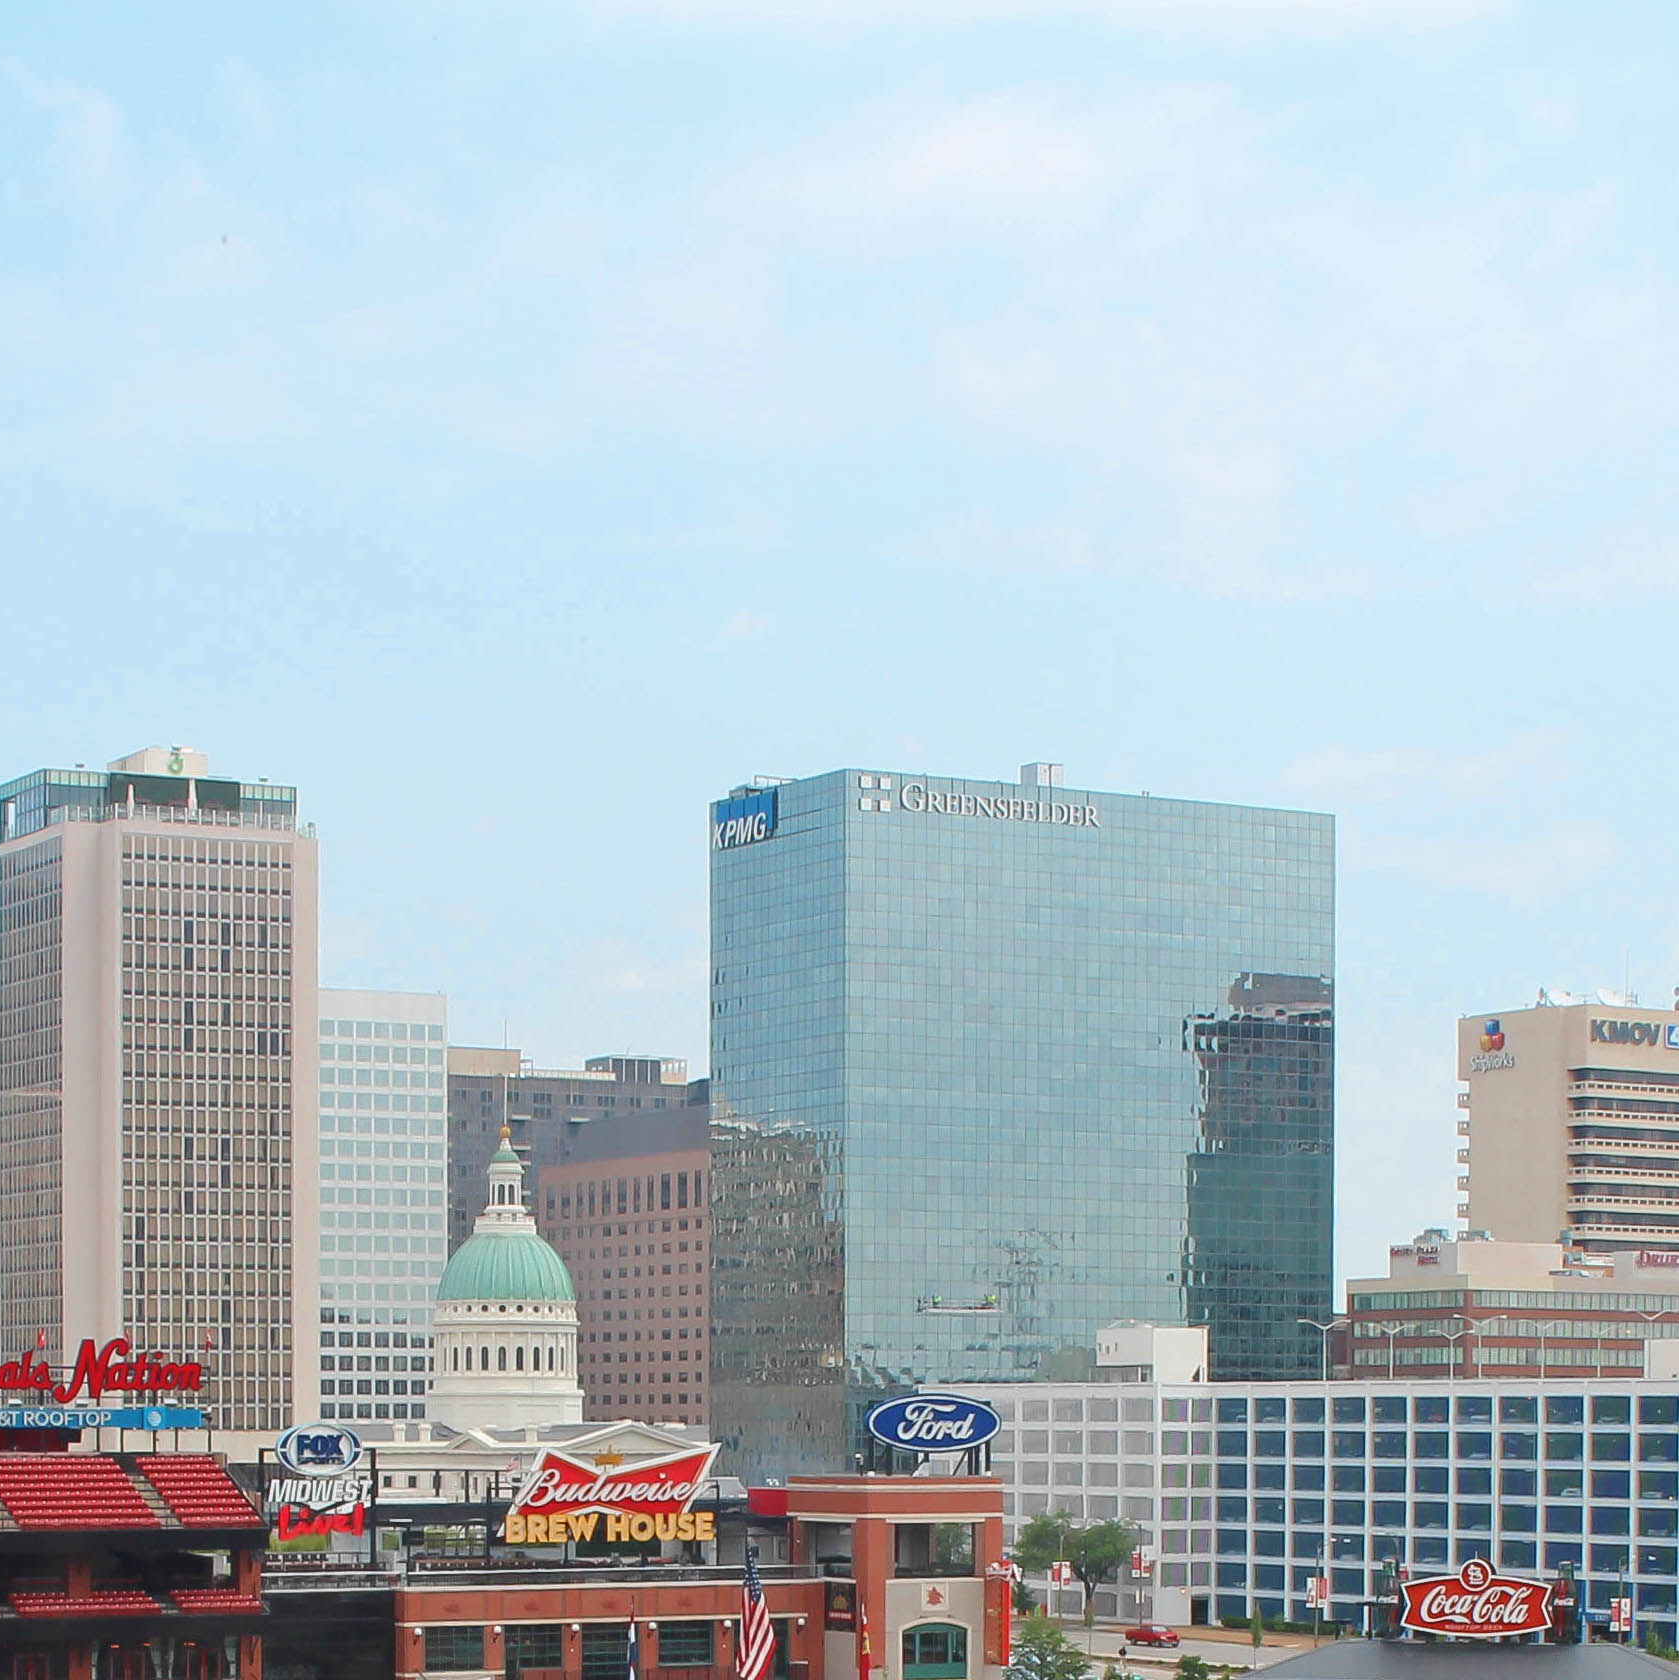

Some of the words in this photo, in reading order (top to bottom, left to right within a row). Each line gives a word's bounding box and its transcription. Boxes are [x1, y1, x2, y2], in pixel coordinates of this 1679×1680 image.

[900, 783, 1100, 828] GREENSFELDER
[712, 812, 767, 850] KPMG
[1590, 1019, 1661, 1047] KMOV
[1471, 1052, 1515, 1073] ShipWorks
[53, 1337, 204, 1404] Nation
[23, 1412, 111, 1427] ROOFTOP
[897, 1402, 975, 1440] Ford
[297, 1434, 344, 1456] FOX
[268, 1479, 373, 1503] MIDWEST
[508, 1468, 715, 1507] Budweiser
[278, 1502, 365, 1541] Live!
[505, 1514, 598, 1543] BREW
[607, 1512, 716, 1542] HOUSE
[1420, 1584, 1533, 1625] Coca-Cola
